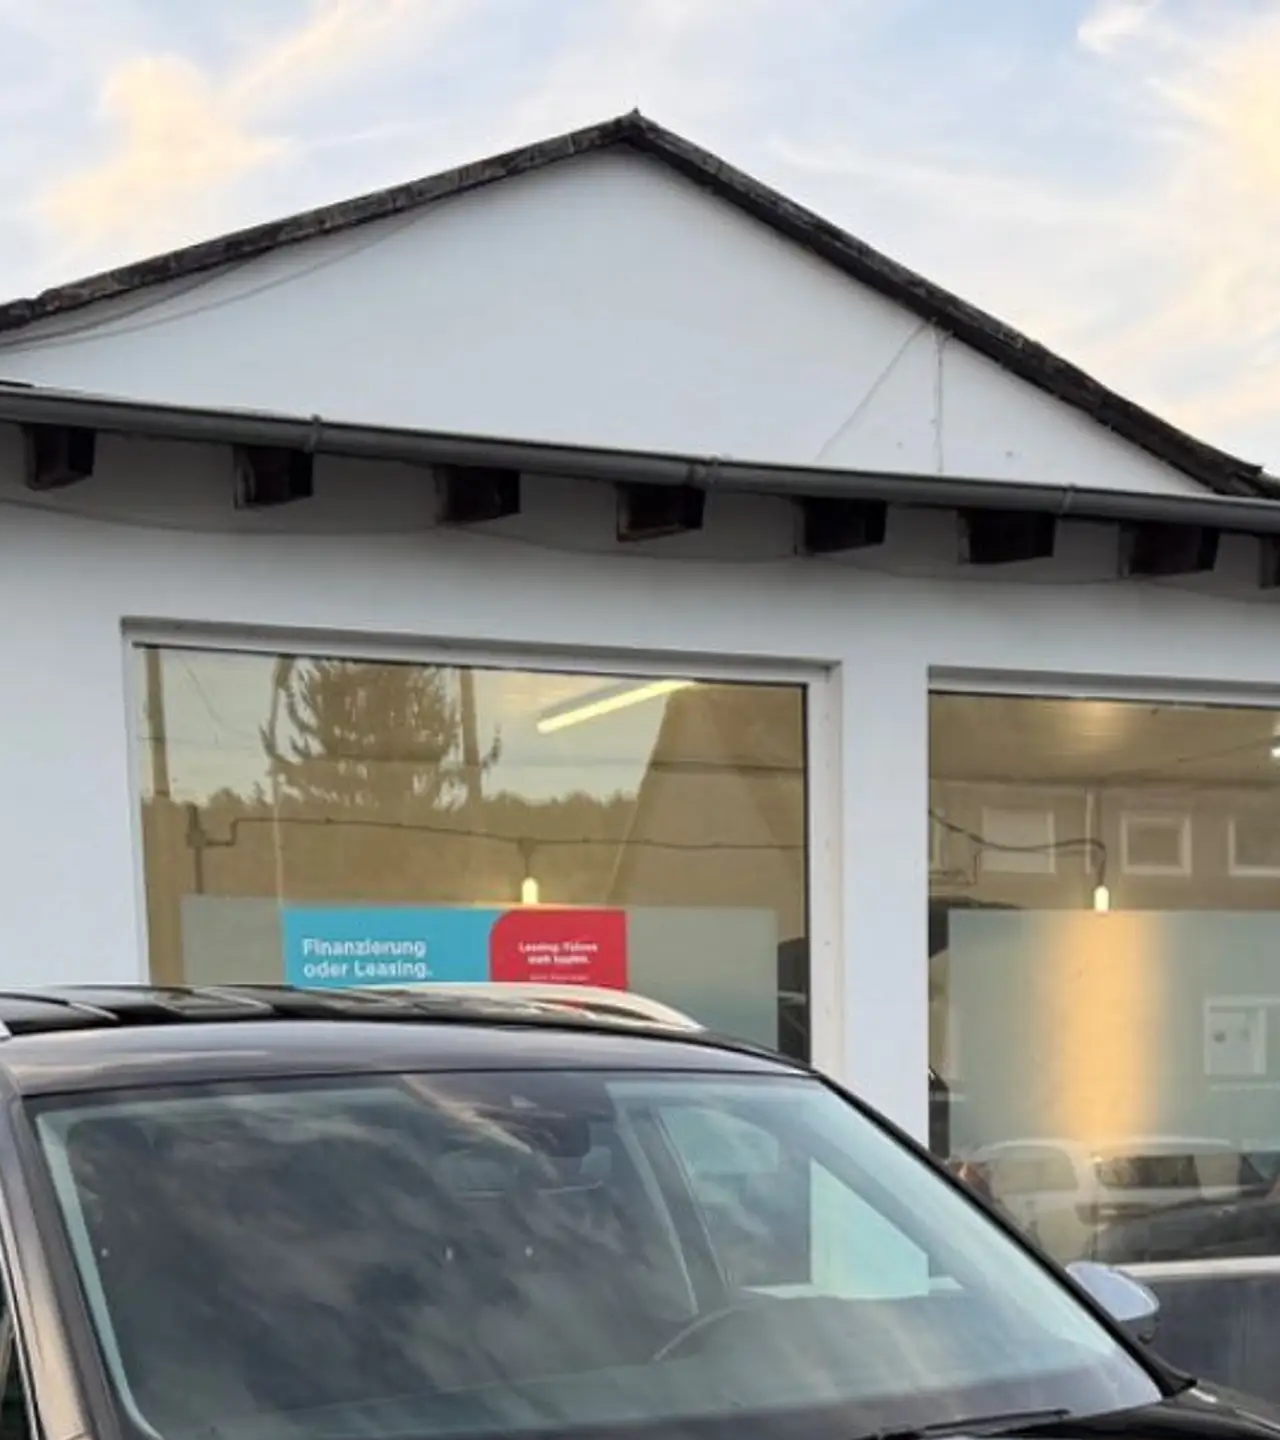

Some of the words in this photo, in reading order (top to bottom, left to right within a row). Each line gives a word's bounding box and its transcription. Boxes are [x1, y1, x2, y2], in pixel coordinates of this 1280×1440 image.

[303, 938, 426, 957] Finanzierung
[303, 961, 348, 979] oder
[354, 960, 433, 980] Leasing.
